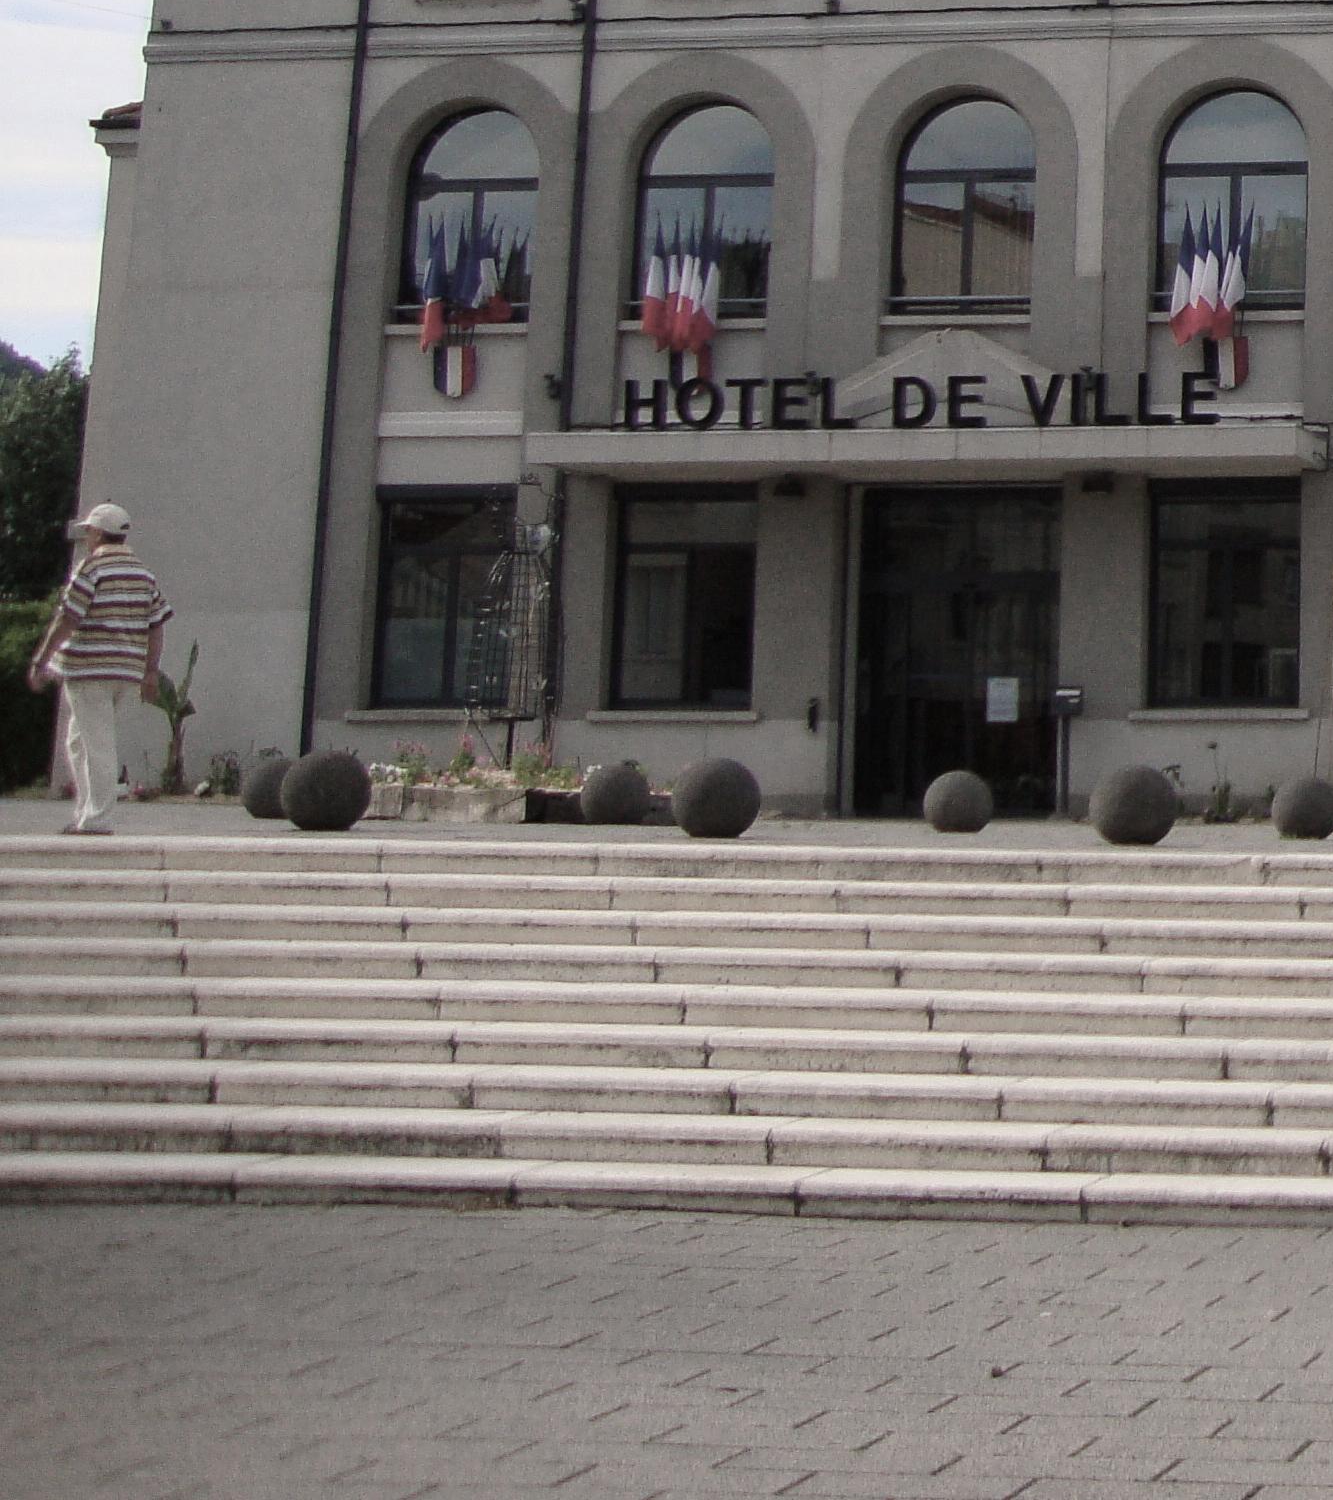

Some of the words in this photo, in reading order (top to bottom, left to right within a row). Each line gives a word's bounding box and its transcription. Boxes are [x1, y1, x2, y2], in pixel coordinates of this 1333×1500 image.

[624, 376, 857, 430] HOTEL
[892, 375, 988, 428] DE
[1021, 372, 1221, 427] VILLE
